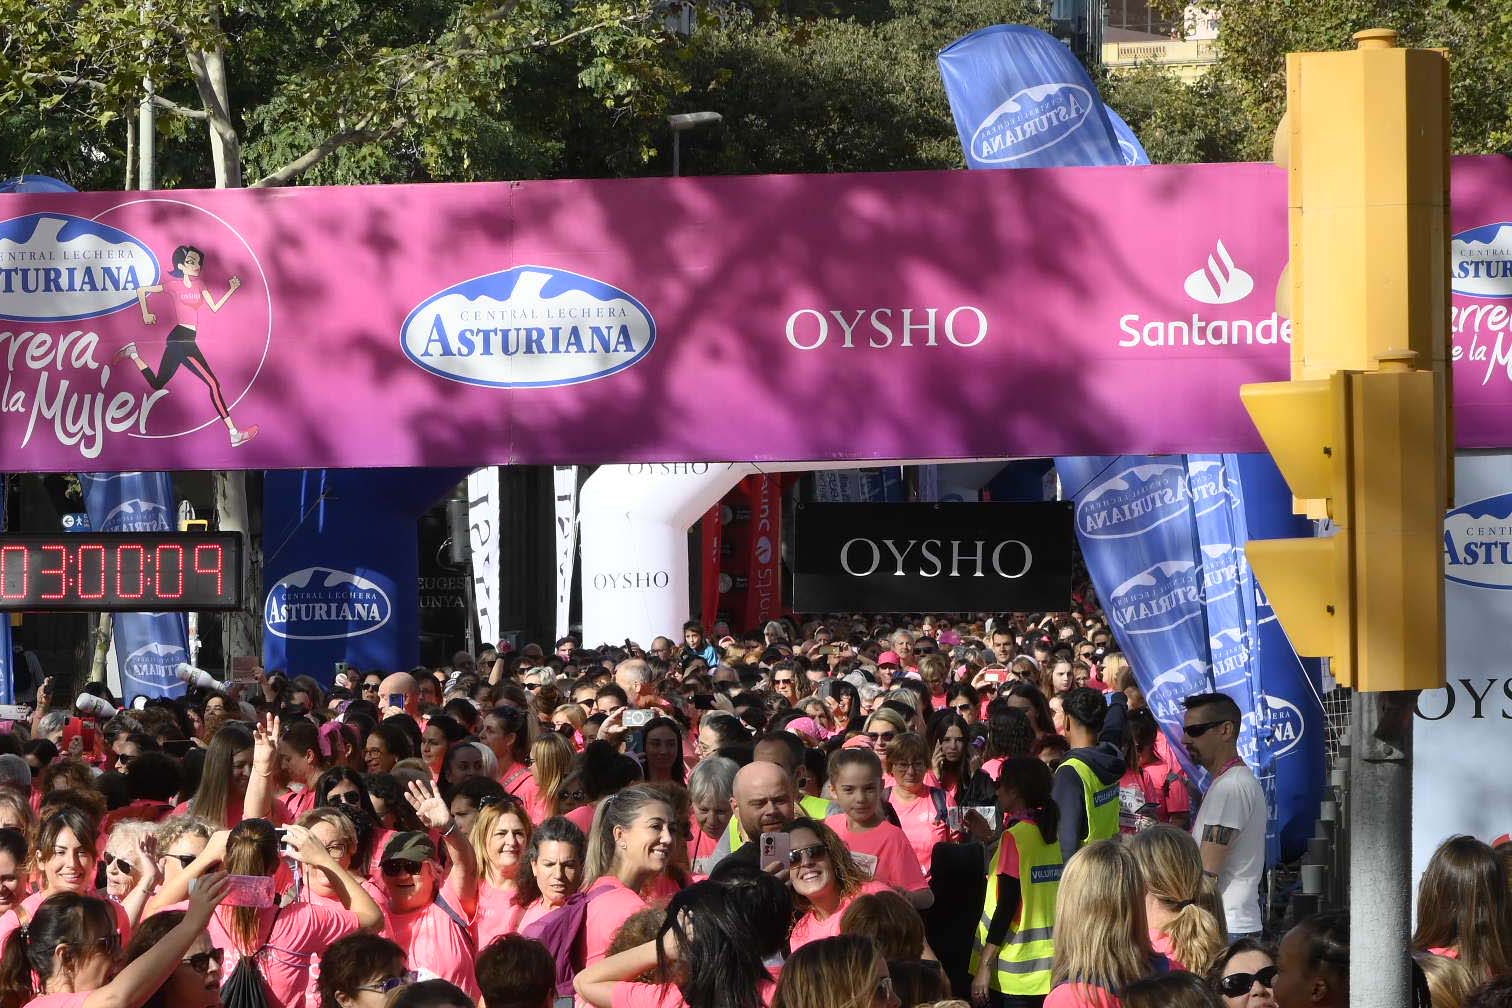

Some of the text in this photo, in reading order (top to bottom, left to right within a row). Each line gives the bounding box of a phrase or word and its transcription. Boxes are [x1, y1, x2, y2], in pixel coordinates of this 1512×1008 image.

[63, 249, 135, 261] LECHERA
[1452, 260, 1512, 278] STUR
[460, 306, 629, 321] CENTRAL LECHERA
[785, 305, 989, 350] OYSHO
[420, 313, 636, 358] ASTURIANA
[1119, 313, 1291, 347] Santande
[1469, 333, 1487, 361] la
[1, 373, 26, 412] la
[21, 365, 169, 459] Mujer
[1466, 527, 1512, 536] CENT
[0, 544, 223, 599] 03:00:09
[839, 537, 1033, 579] OYSHO
[593, 570, 670, 591] OYSHO
[269, 596, 382, 624] ASTURIANA
[282, 592, 324, 600] CENTRAL
[419, 596, 465, 608] UNYA
